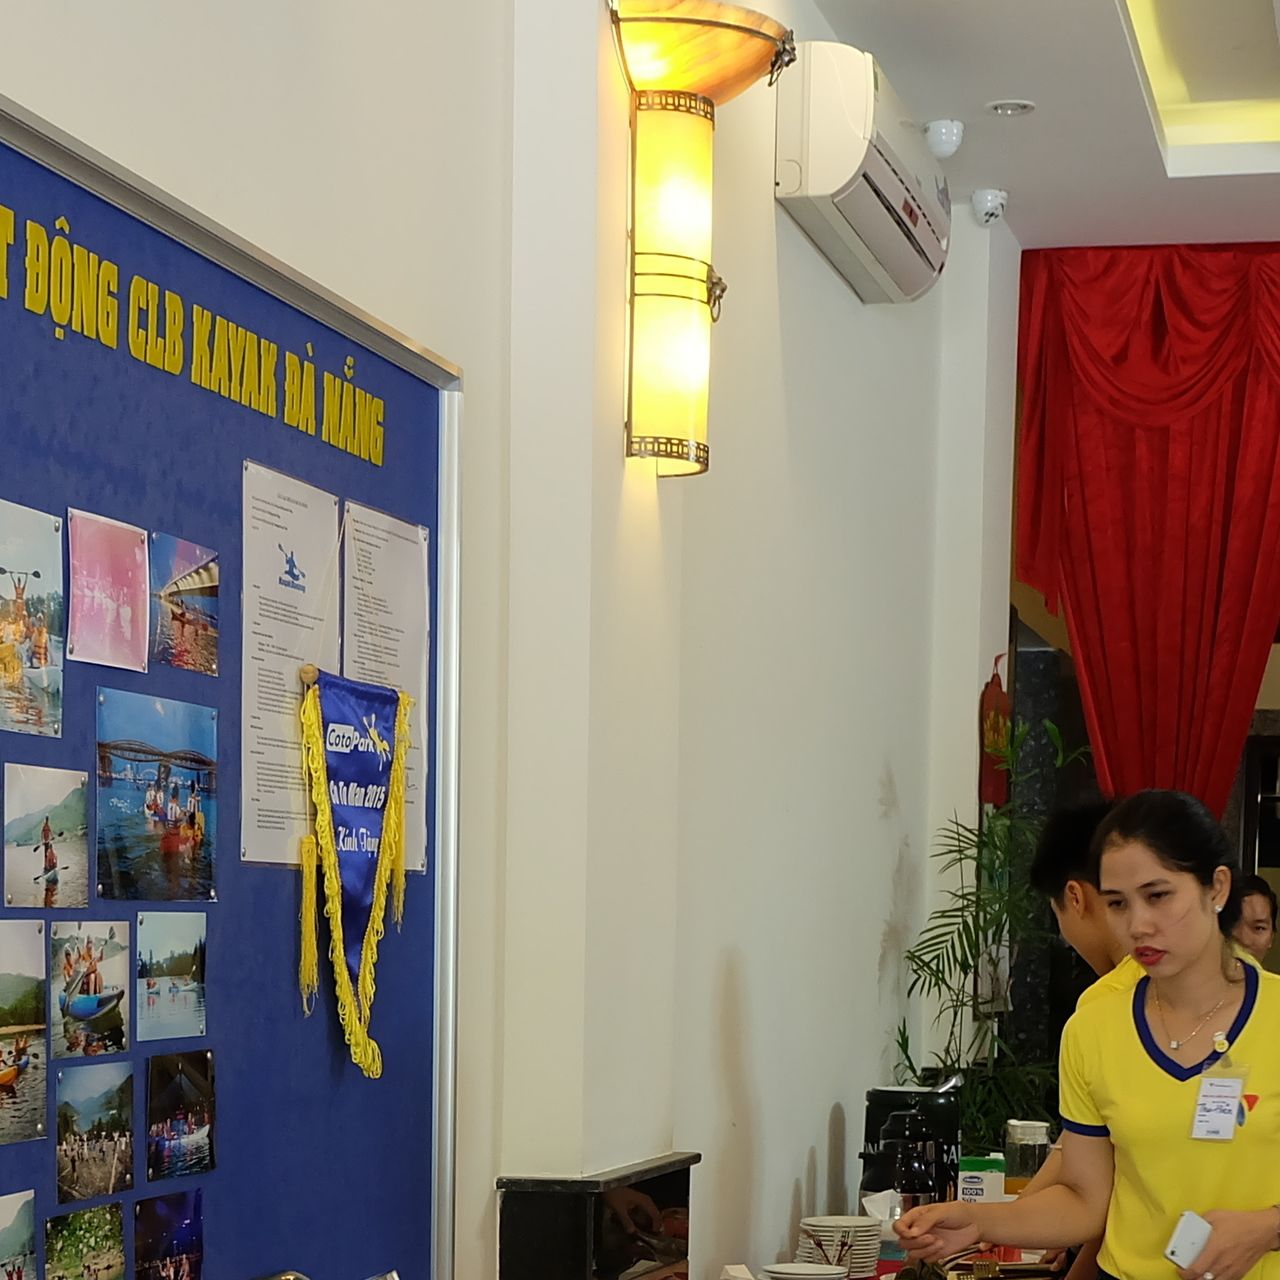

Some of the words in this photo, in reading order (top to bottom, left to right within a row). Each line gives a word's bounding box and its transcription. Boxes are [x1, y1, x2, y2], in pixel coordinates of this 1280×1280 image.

[24, 216, 118, 350] ĐỘNG
[128, 275, 184, 375] CLB
[191, 304, 277, 418] KAYAK
[284, 342, 315, 436] ĐÀ
